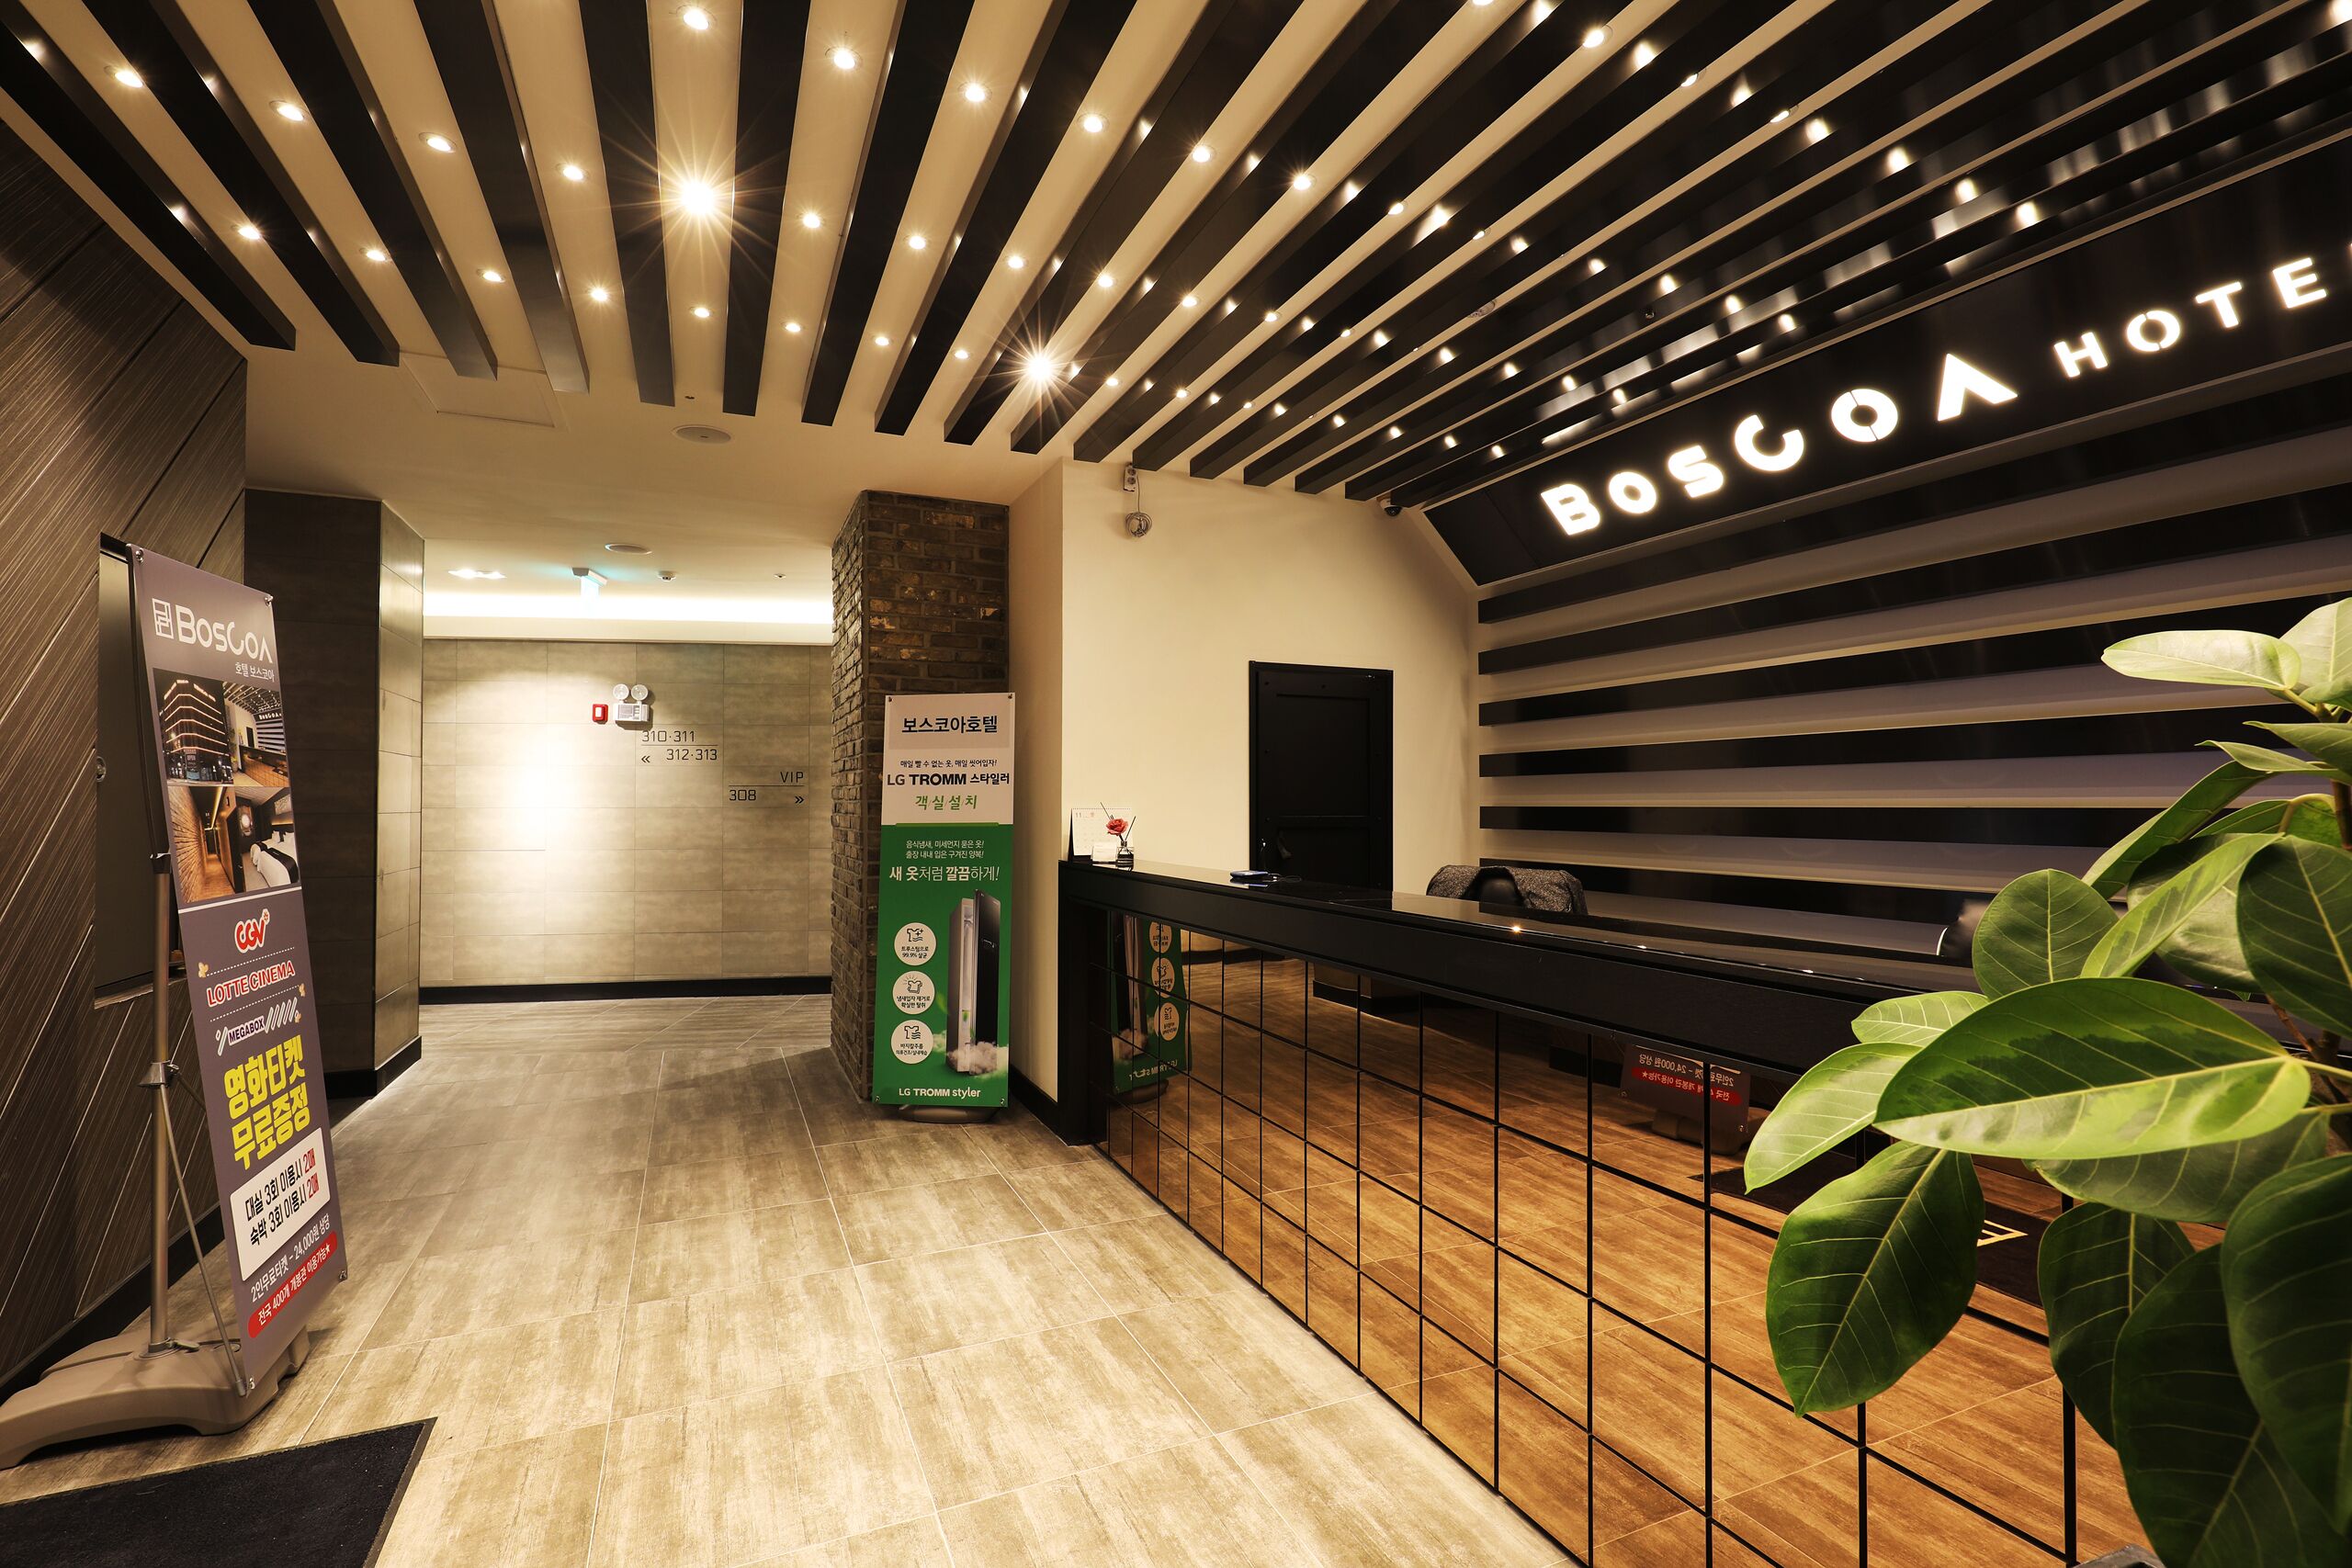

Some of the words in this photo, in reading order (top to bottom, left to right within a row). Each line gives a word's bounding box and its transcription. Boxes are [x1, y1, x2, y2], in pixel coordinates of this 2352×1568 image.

[2053, 243, 2352, 378] HOTE
[235, 662, 249, 678] 호텔
[250, 665, 275, 682] 보스코아
[901, 716, 998, 734] 보스코아호텔
[956, 760, 967, 768] 매일
[969, 759, 997, 768] 씻어입자!
[780, 772, 804, 783] VIP
[888, 774, 905, 785] LG
[909, 773, 967, 785] TROMM
[970, 773, 1010, 784] 스타일러
[729, 790, 757, 801] 308
[906, 840, 933, 849] 음식냄새,
[934, 840, 960, 849] 미세먼지
[961, 840, 974, 849] 묻은
[975, 840, 985, 849] 옷!
[906, 851, 919, 859] 출장
[934, 851, 946, 859] 입은
[889, 866, 902, 881] 새
[906, 866, 943, 881] 옷처럼
[946, 866, 1000, 881] 깔끔하게!
[235, 918, 266, 953] CGV
[207, 976, 248, 1008] LOTTE
[249, 961, 295, 990] CINEMA
[229, 1017, 265, 1043] MEGABOX
[223, 1034, 306, 1120] 영화티켓
[899, 1088, 910, 1096] LG
[913, 1088, 950, 1097] TROMM
[952, 1087, 981, 1099] styler
[232, 1082, 311, 1170] 무료증정
[245, 1190, 264, 1222] 대실
[265, 1177, 279, 1205] 3회
[279, 1158, 303, 1192] 이용시
[303, 1147, 316, 1174] 2매
[250, 1218, 268, 1246] 숙박
[268, 1204, 283, 1233] 3회
[284, 1184, 307, 1218] 이용시
[307, 1172, 320, 1199] 2매
[251, 1255, 288, 1303] 2인무료티켓
[294, 1224, 320, 1260] 24,000원
[320, 1213, 330, 1235] 상당
[258, 1303, 272, 1325] 전국
[272, 1283, 290, 1310] 400개
[290, 1266, 307, 1292] 개봉관
